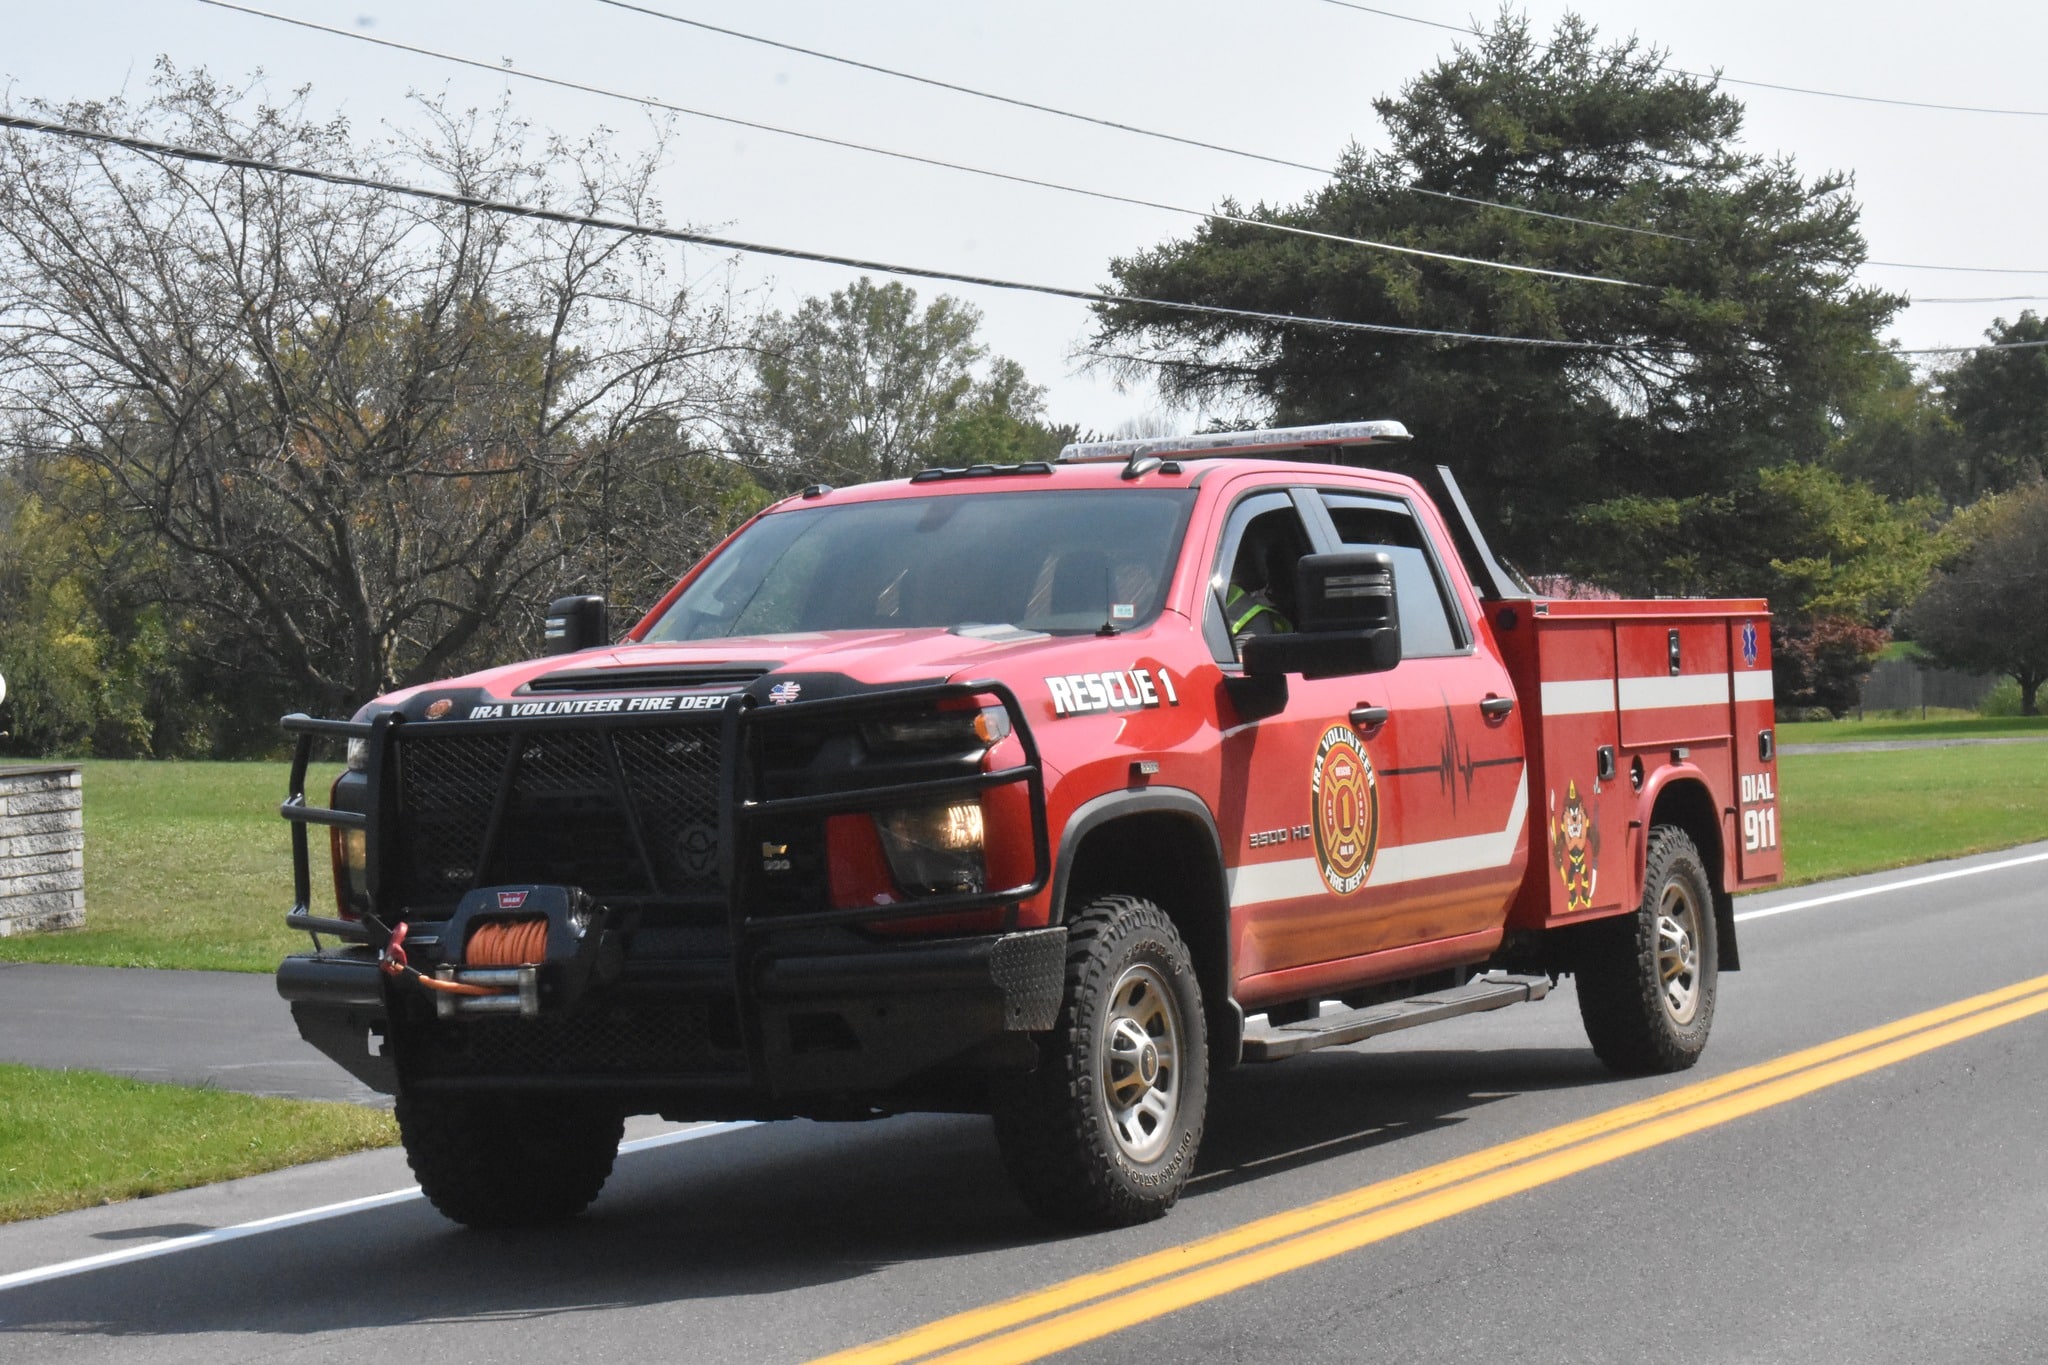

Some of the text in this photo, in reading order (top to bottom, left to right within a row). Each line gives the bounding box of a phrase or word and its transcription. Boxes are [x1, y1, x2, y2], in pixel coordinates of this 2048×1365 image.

[469, 704, 503, 719] IRA
[511, 699, 623, 717] VOLUNTEER
[627, 697, 676, 711] FIRE
[678, 695, 729, 710] DEPT
[1044, 668, 1178, 716] RESCUE 1
[1312, 727, 1375, 793] IRA VOLUNTEER
[1741, 772, 1775, 803] DIAL
[1249, 824, 1311, 847] 3500 HD
[1744, 807, 1777, 851] 911
[1325, 863, 1345, 893] FIRE
